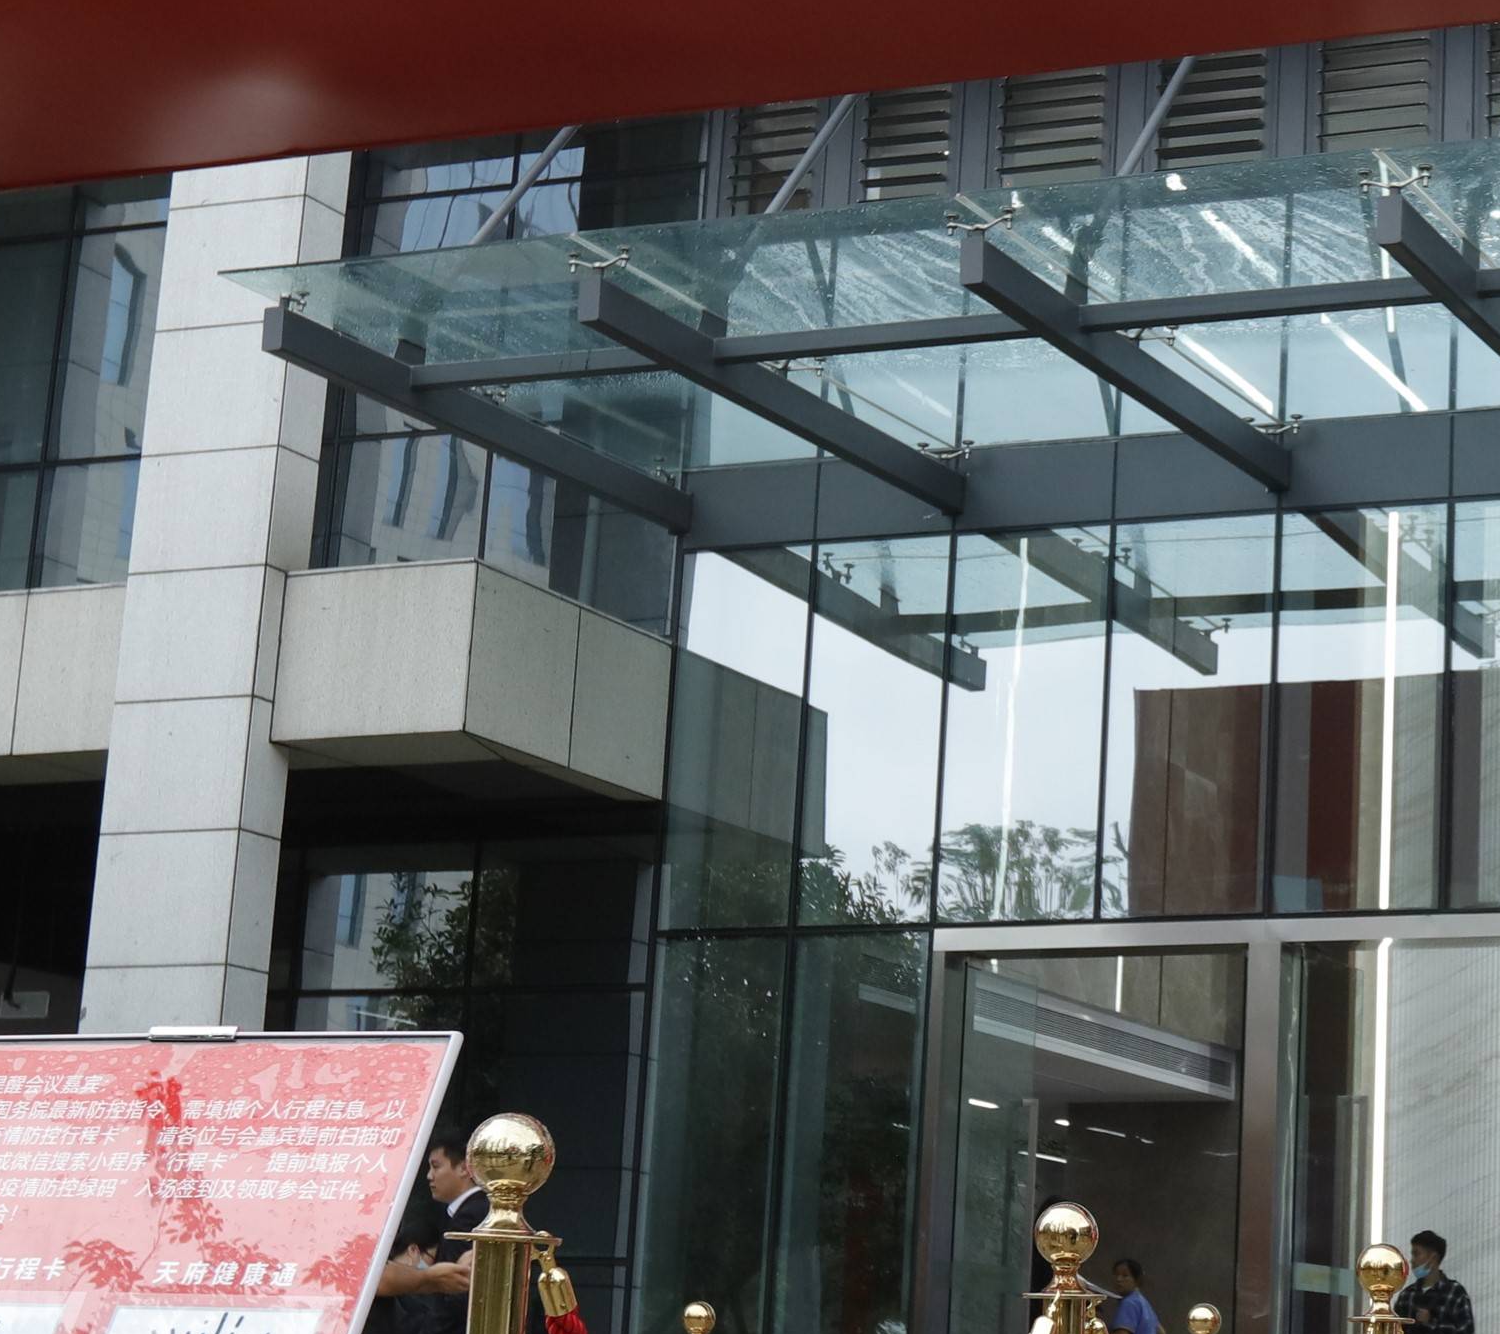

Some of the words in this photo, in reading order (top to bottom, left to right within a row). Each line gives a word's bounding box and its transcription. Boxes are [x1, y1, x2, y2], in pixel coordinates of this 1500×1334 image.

[154, 1260, 298, 1287] 天府健康通
